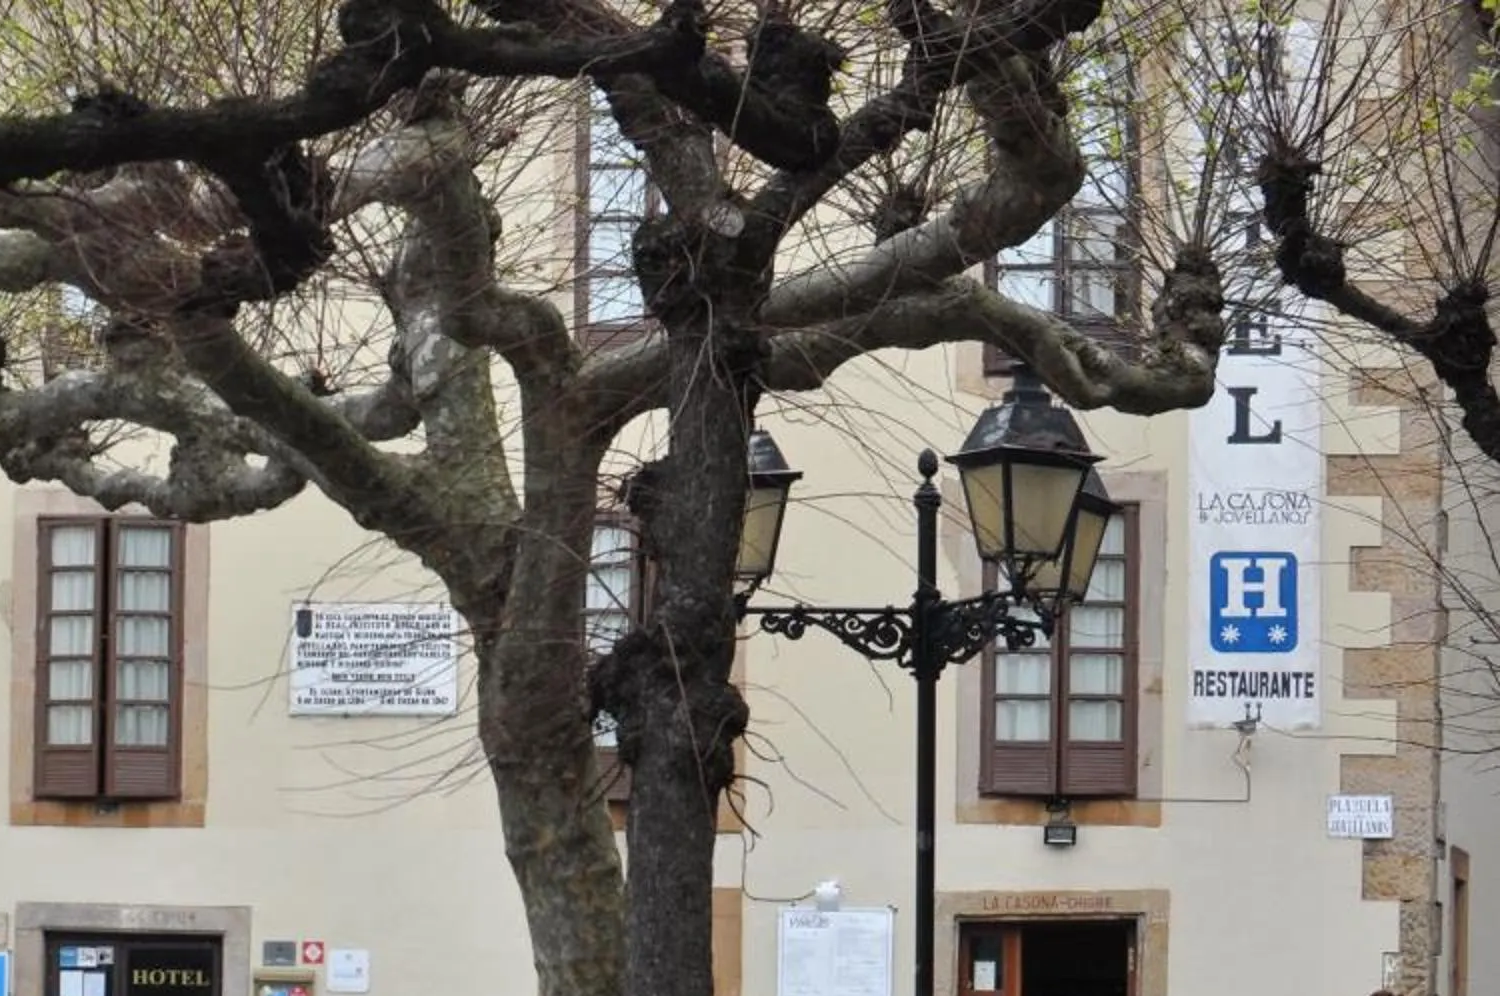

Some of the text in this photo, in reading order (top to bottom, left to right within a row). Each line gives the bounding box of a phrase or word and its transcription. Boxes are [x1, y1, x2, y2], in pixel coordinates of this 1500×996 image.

[1198, 492, 1224, 510] LA
[1220, 557, 1288, 617] H
[1193, 670, 1315, 698] RESTAURANTE
[132, 968, 210, 987] HOTEL
